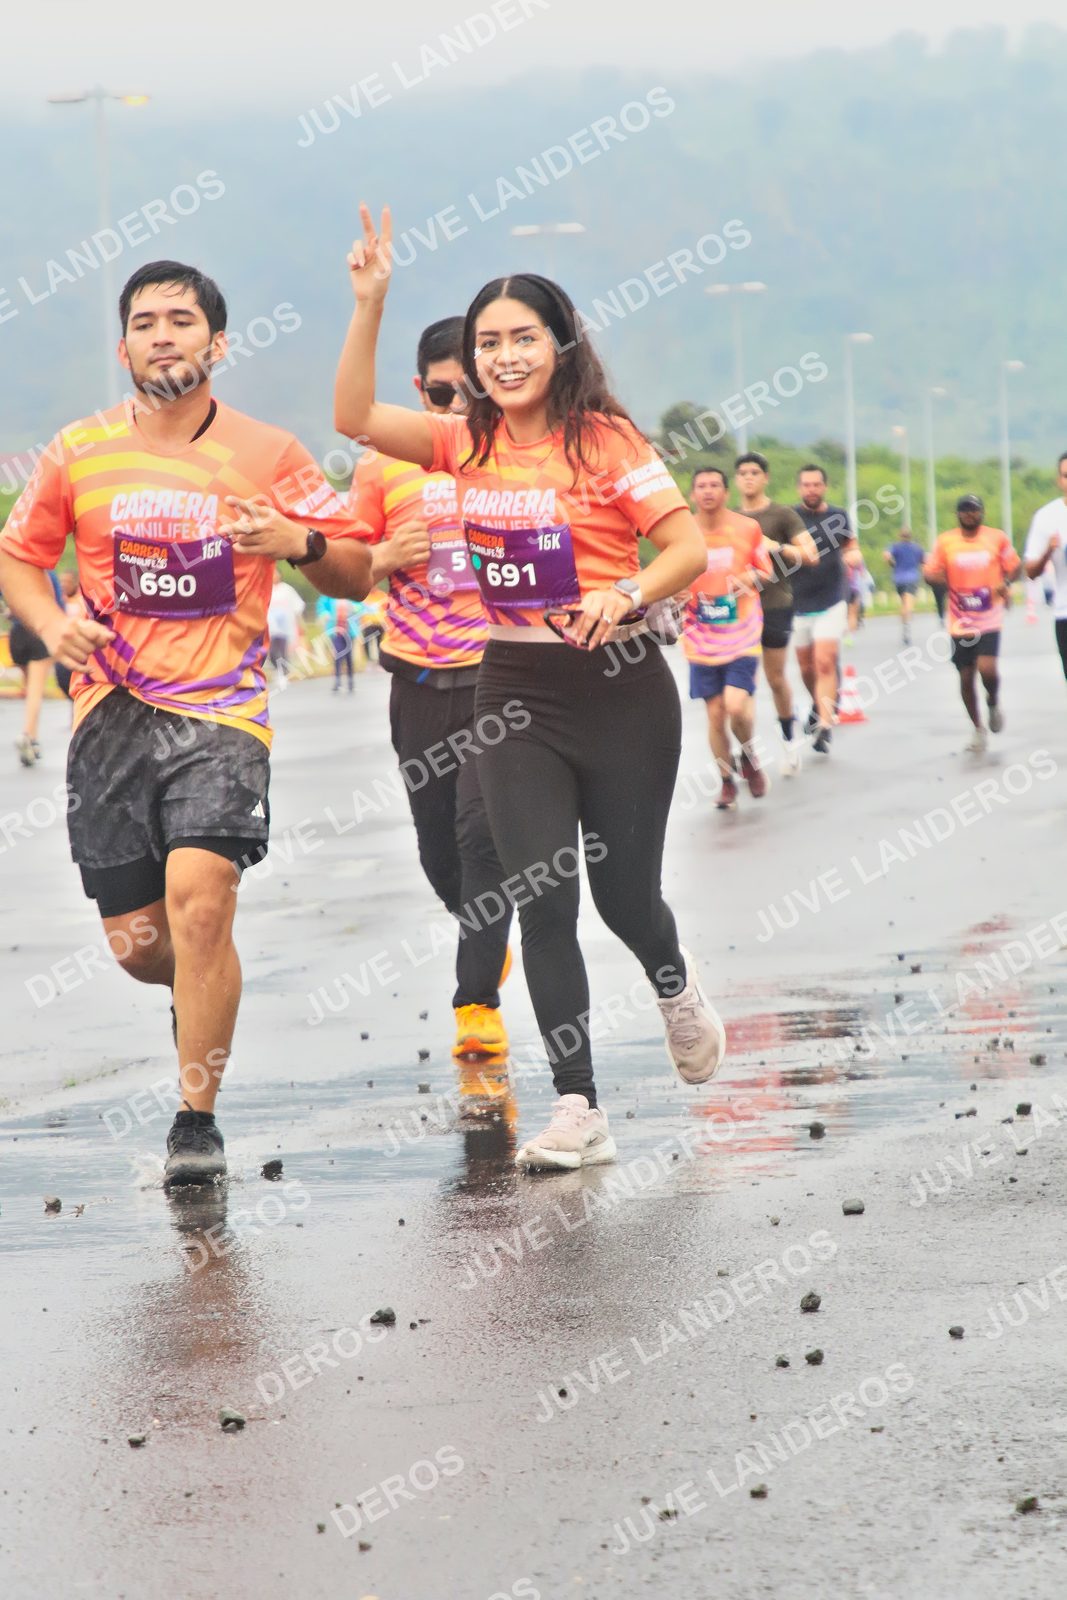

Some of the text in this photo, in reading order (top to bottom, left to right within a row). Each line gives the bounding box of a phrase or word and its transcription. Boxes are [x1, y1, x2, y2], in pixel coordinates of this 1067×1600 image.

[111, 490, 218, 521] CARRERA
[462, 488, 556, 516] CARRERA
[119, 540, 168, 557] CARRERA
[469, 530, 504, 547] CARRERA
[140, 572, 197, 598] 690
[486, 563, 537, 587] 691
